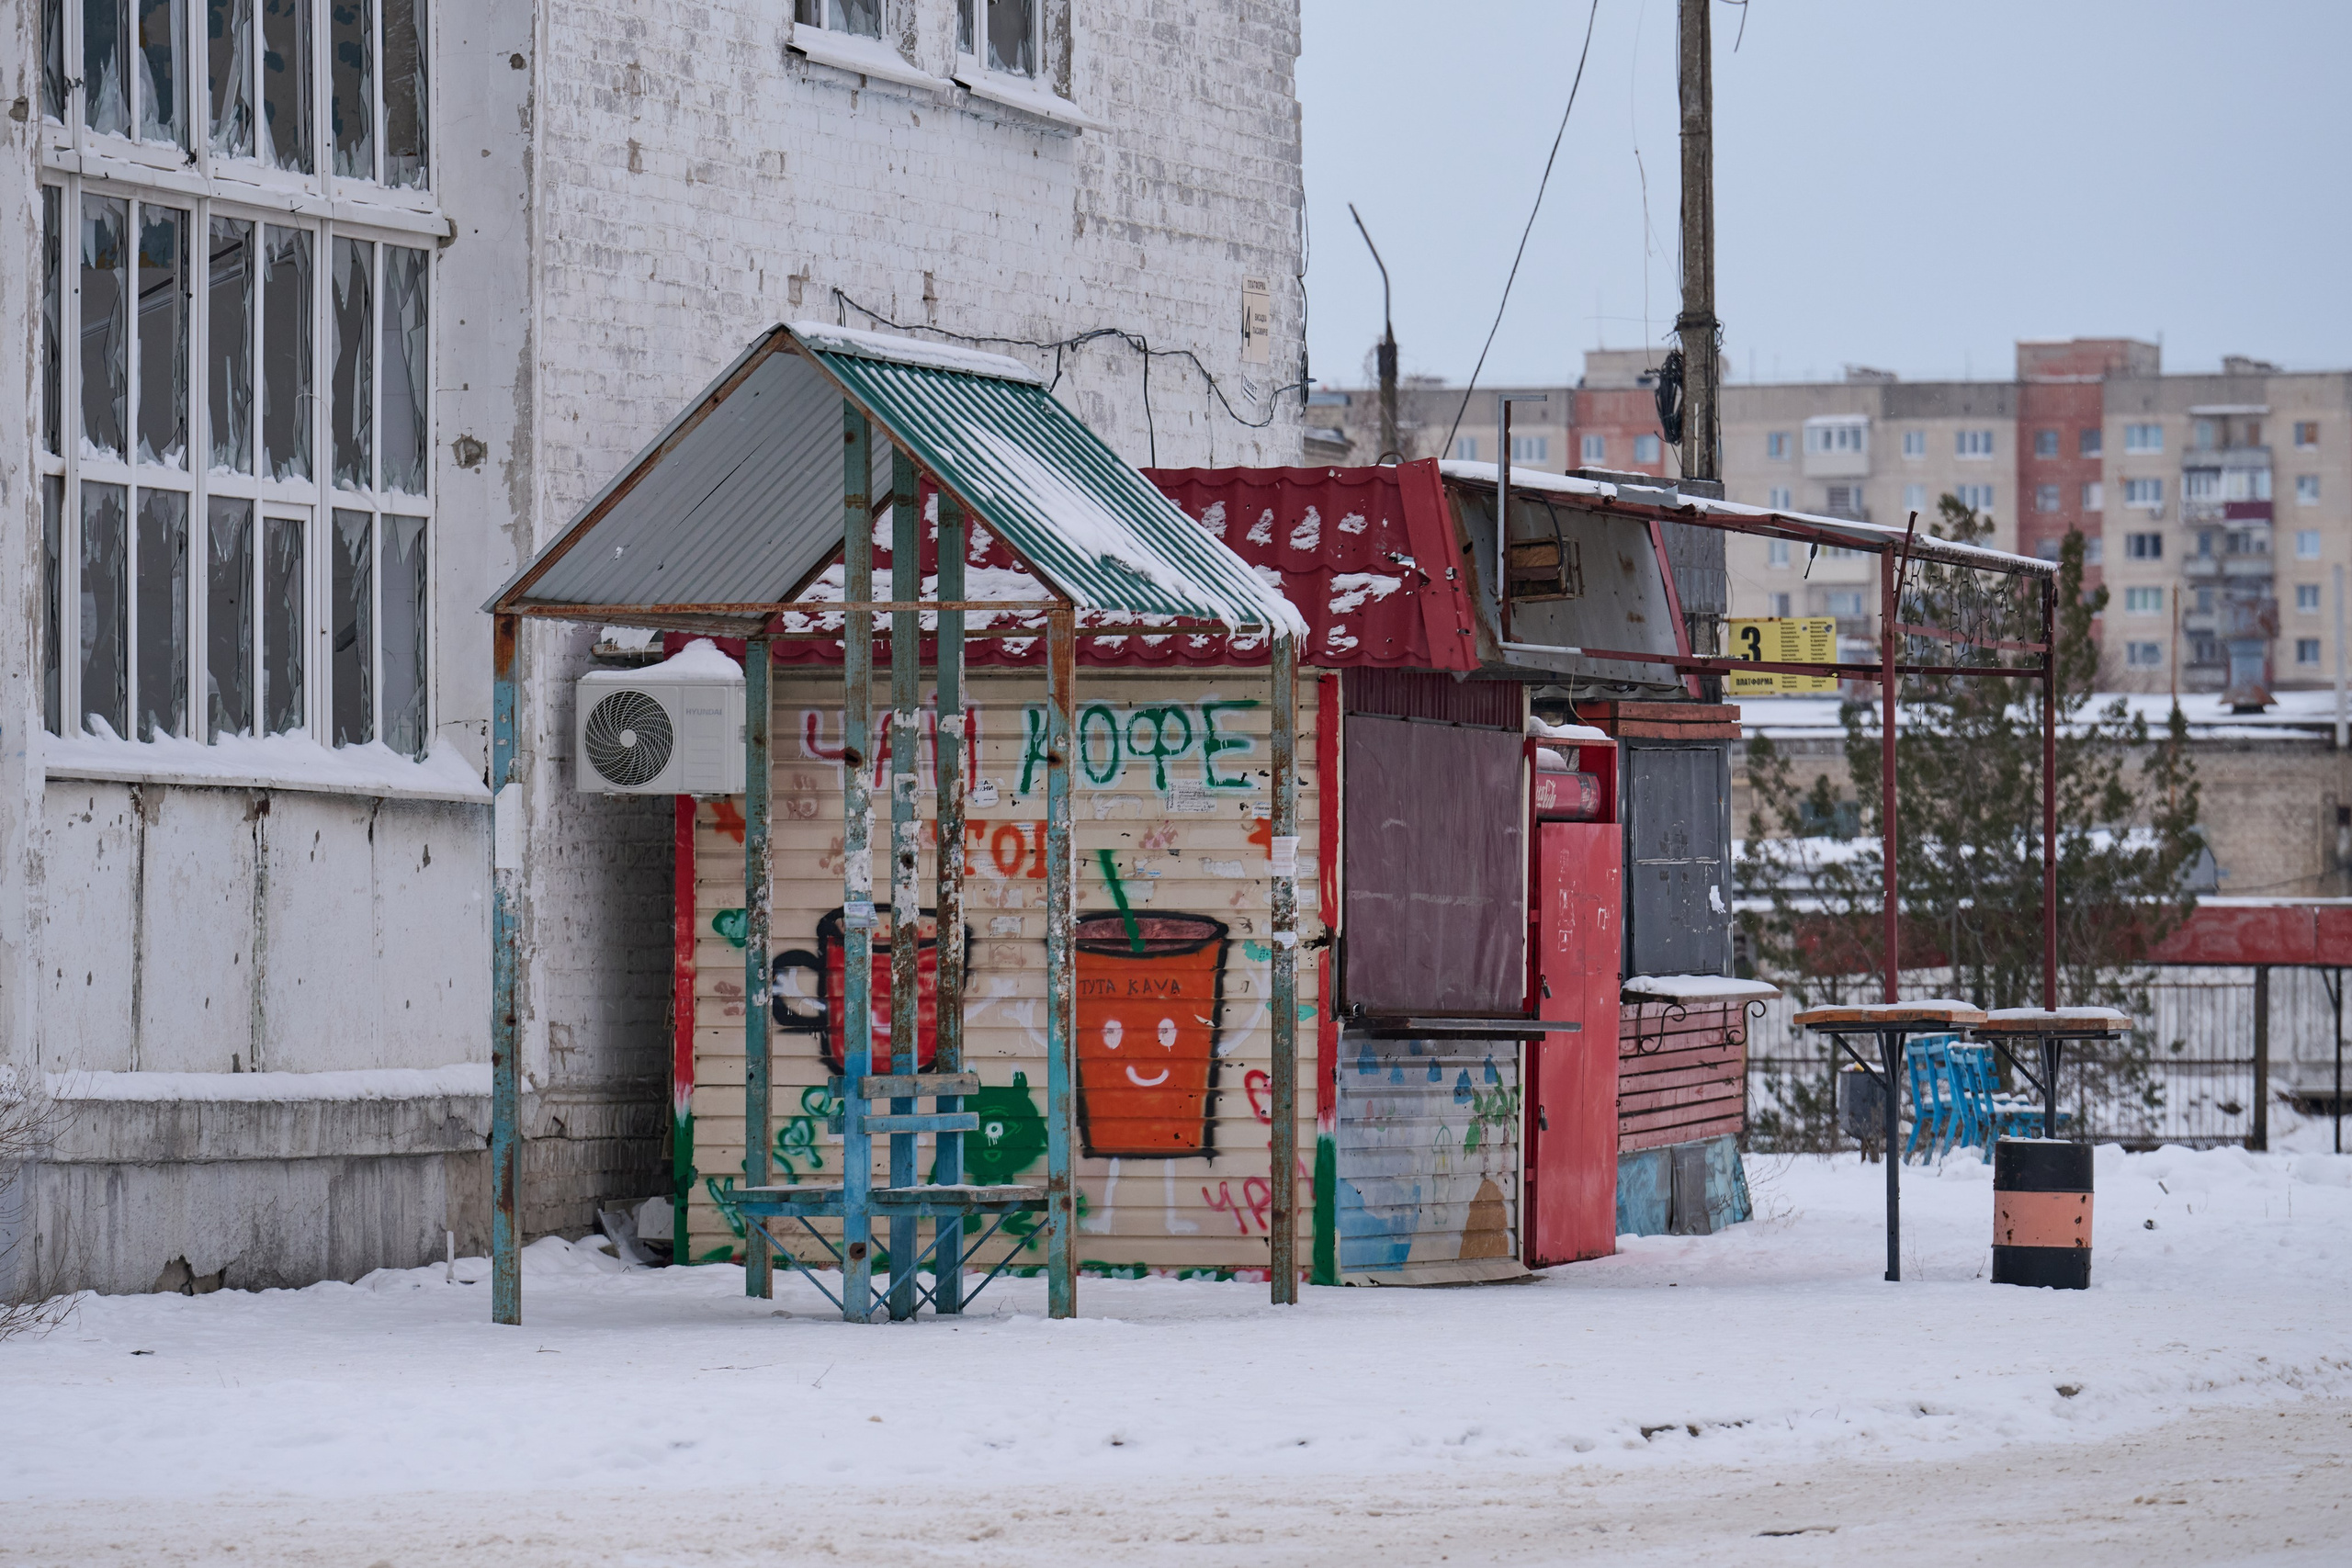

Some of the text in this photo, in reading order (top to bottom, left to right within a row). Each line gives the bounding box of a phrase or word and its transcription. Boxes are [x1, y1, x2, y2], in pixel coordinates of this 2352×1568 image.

[1247, 280, 1266, 290] ПЛАТФОРМА
[1245, 306, 1250, 347] 4
[1244, 376, 1257, 394] ТУАЛЕТ
[1741, 626, 1761, 661] 3
[1736, 678, 1773, 686] ПЛАТФОРМА
[1018, 699, 1261, 795] КОФЕ
